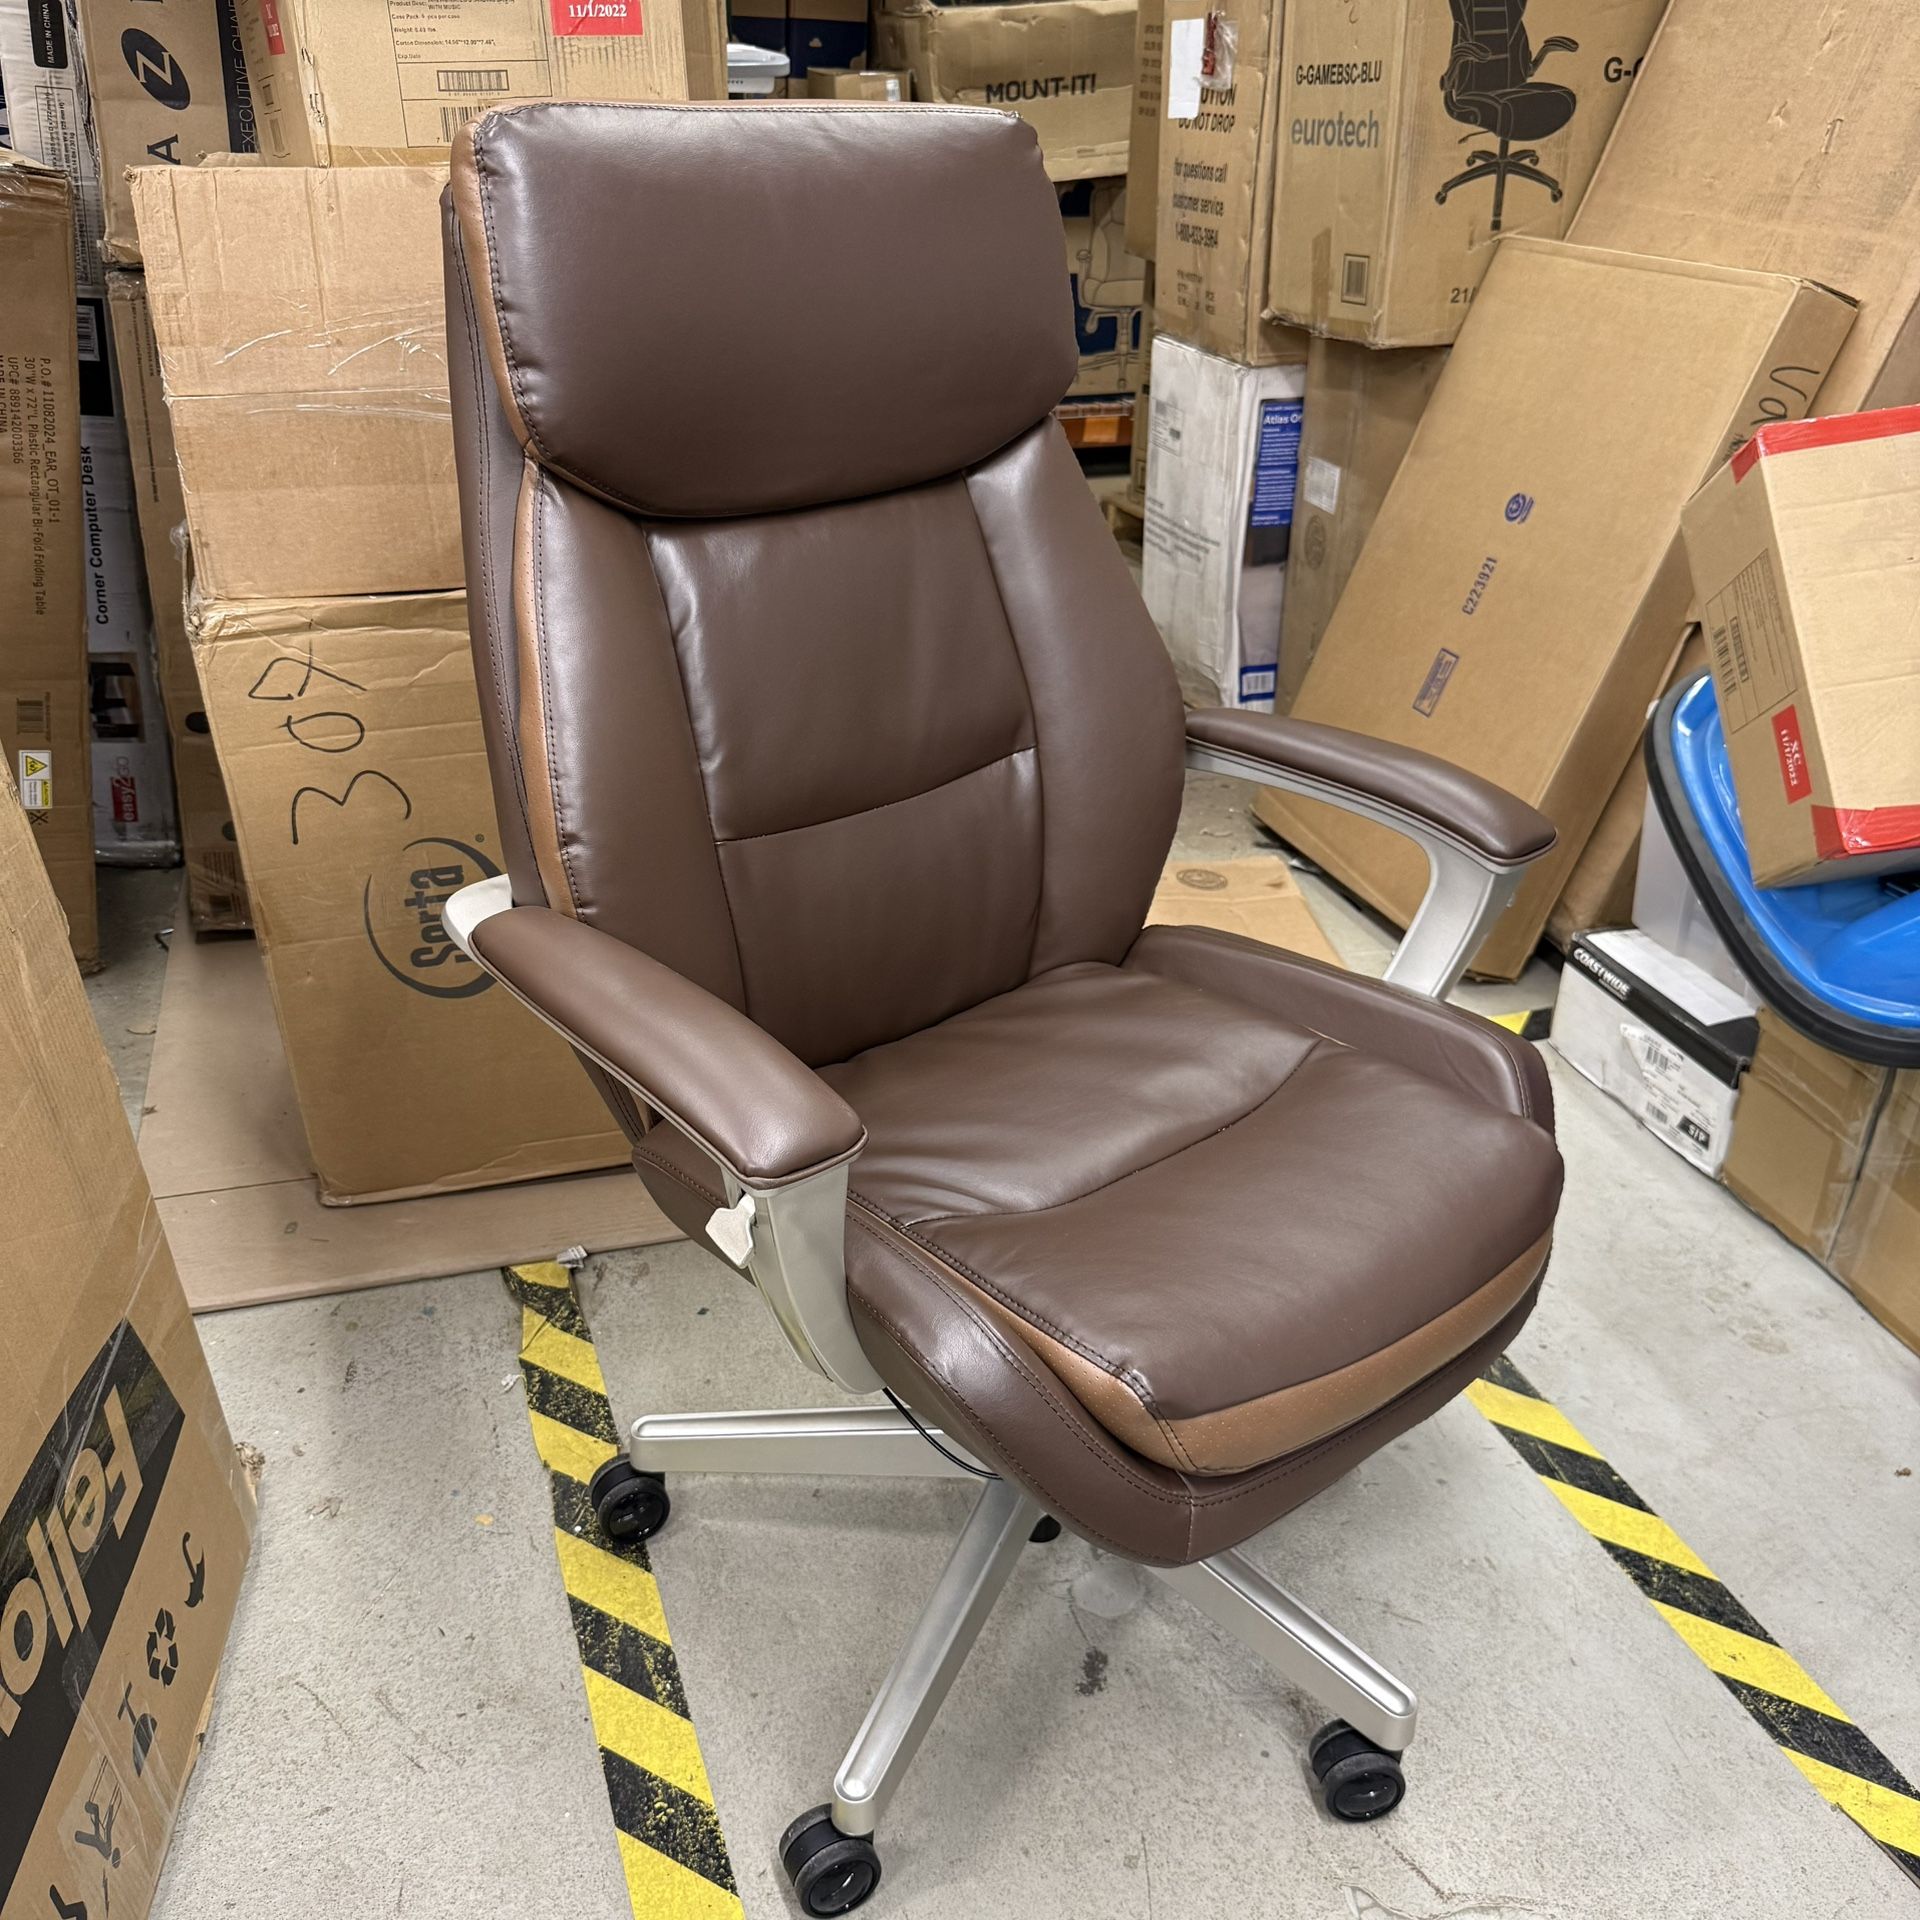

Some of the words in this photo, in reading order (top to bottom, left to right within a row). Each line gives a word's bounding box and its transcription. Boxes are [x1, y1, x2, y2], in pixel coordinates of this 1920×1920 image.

[42, 4, 51, 29] CHINA
[568, 4, 627, 17] 11/1/2022
[44, 30, 52, 38] IN
[46, 40, 55, 64] MADE
[986, 73, 1097, 104] MOUNT-IT!
[1296, 60, 1382, 85] G-GAMEBSC-BLU
[1211, 114, 1235, 133] DROP
[1291, 109, 1380, 148] eurotech
[8, 357, 20, 384] UPC#
[10, 389, 24, 464] 889142003366
[1263, 414, 1290, 425] Atlas
[28, 424, 40, 456] Plastic
[80, 446, 96, 487] Desk
[30, 459, 44, 515] Rectangular
[32, 518, 44, 552] Bi-Fold
[85, 490, 102, 568] Computer
[33, 554, 46, 588] Folding
[1462, 556, 1498, 615] C223921
[36, 590, 46, 616] Table
[96, 574, 109, 625] Corner
[404, 865, 474, 968] Serta
[1573, 948, 1632, 995] COASTWIDE
